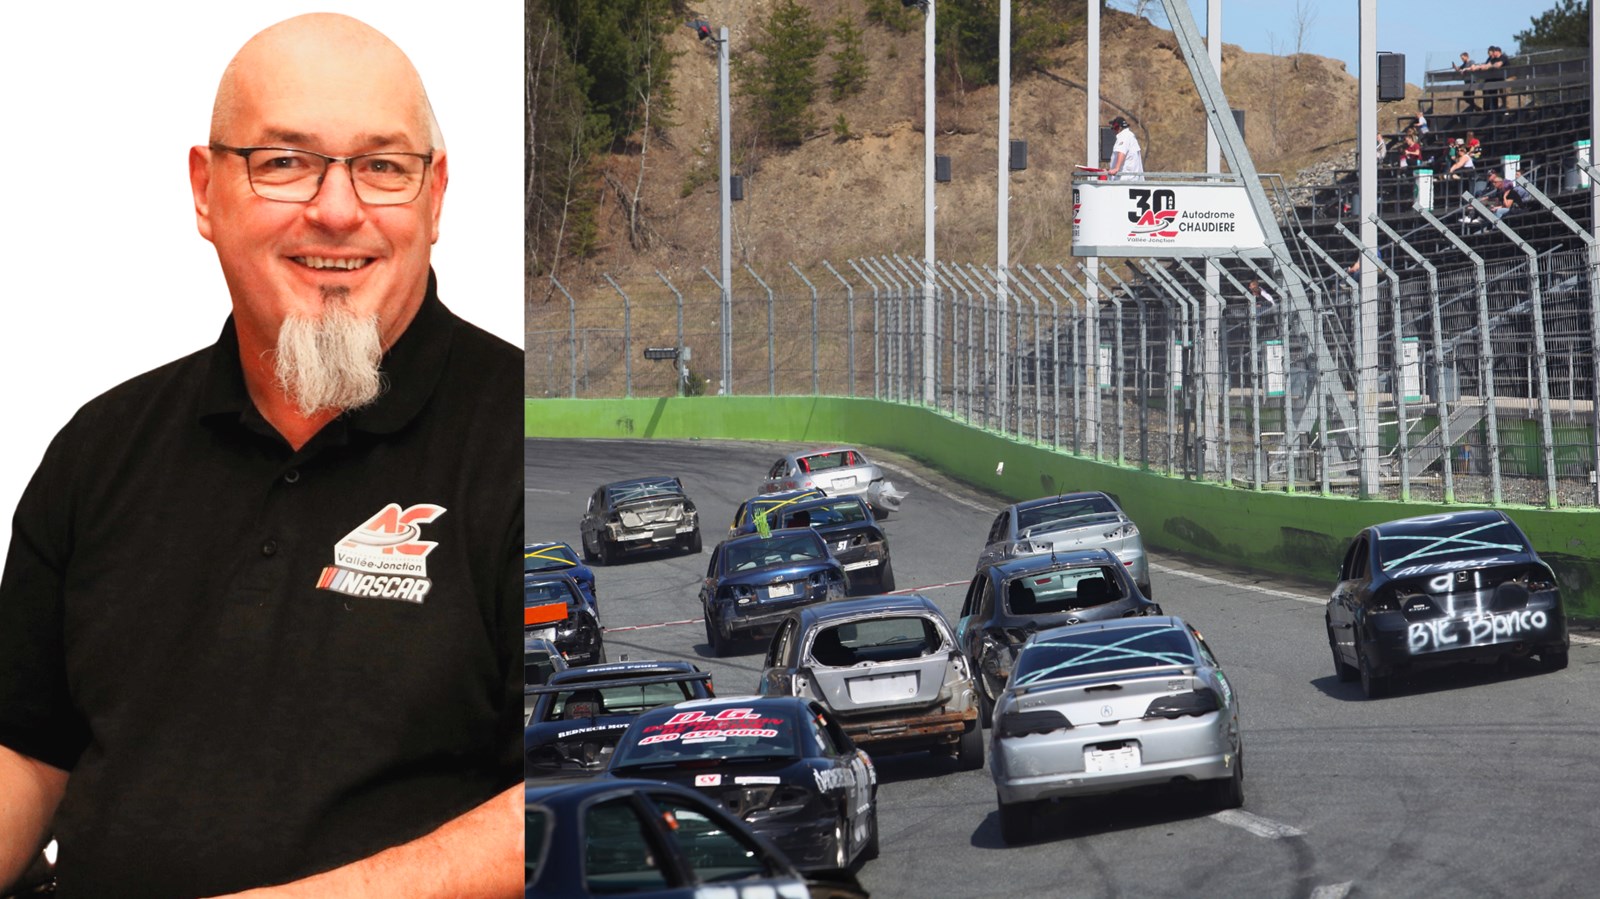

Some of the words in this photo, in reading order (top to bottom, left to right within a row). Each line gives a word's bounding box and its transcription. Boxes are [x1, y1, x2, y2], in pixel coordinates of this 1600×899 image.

[1127, 189, 1176, 224] 30
[1181, 210, 1236, 220] Autodrome
[1178, 221, 1236, 233] CHAUDIERE
[837, 540, 848, 551] 51
[338, 571, 431, 603] NASCAR
[1407, 619, 1458, 655] BYE
[557, 725, 606, 739] REDNECK
